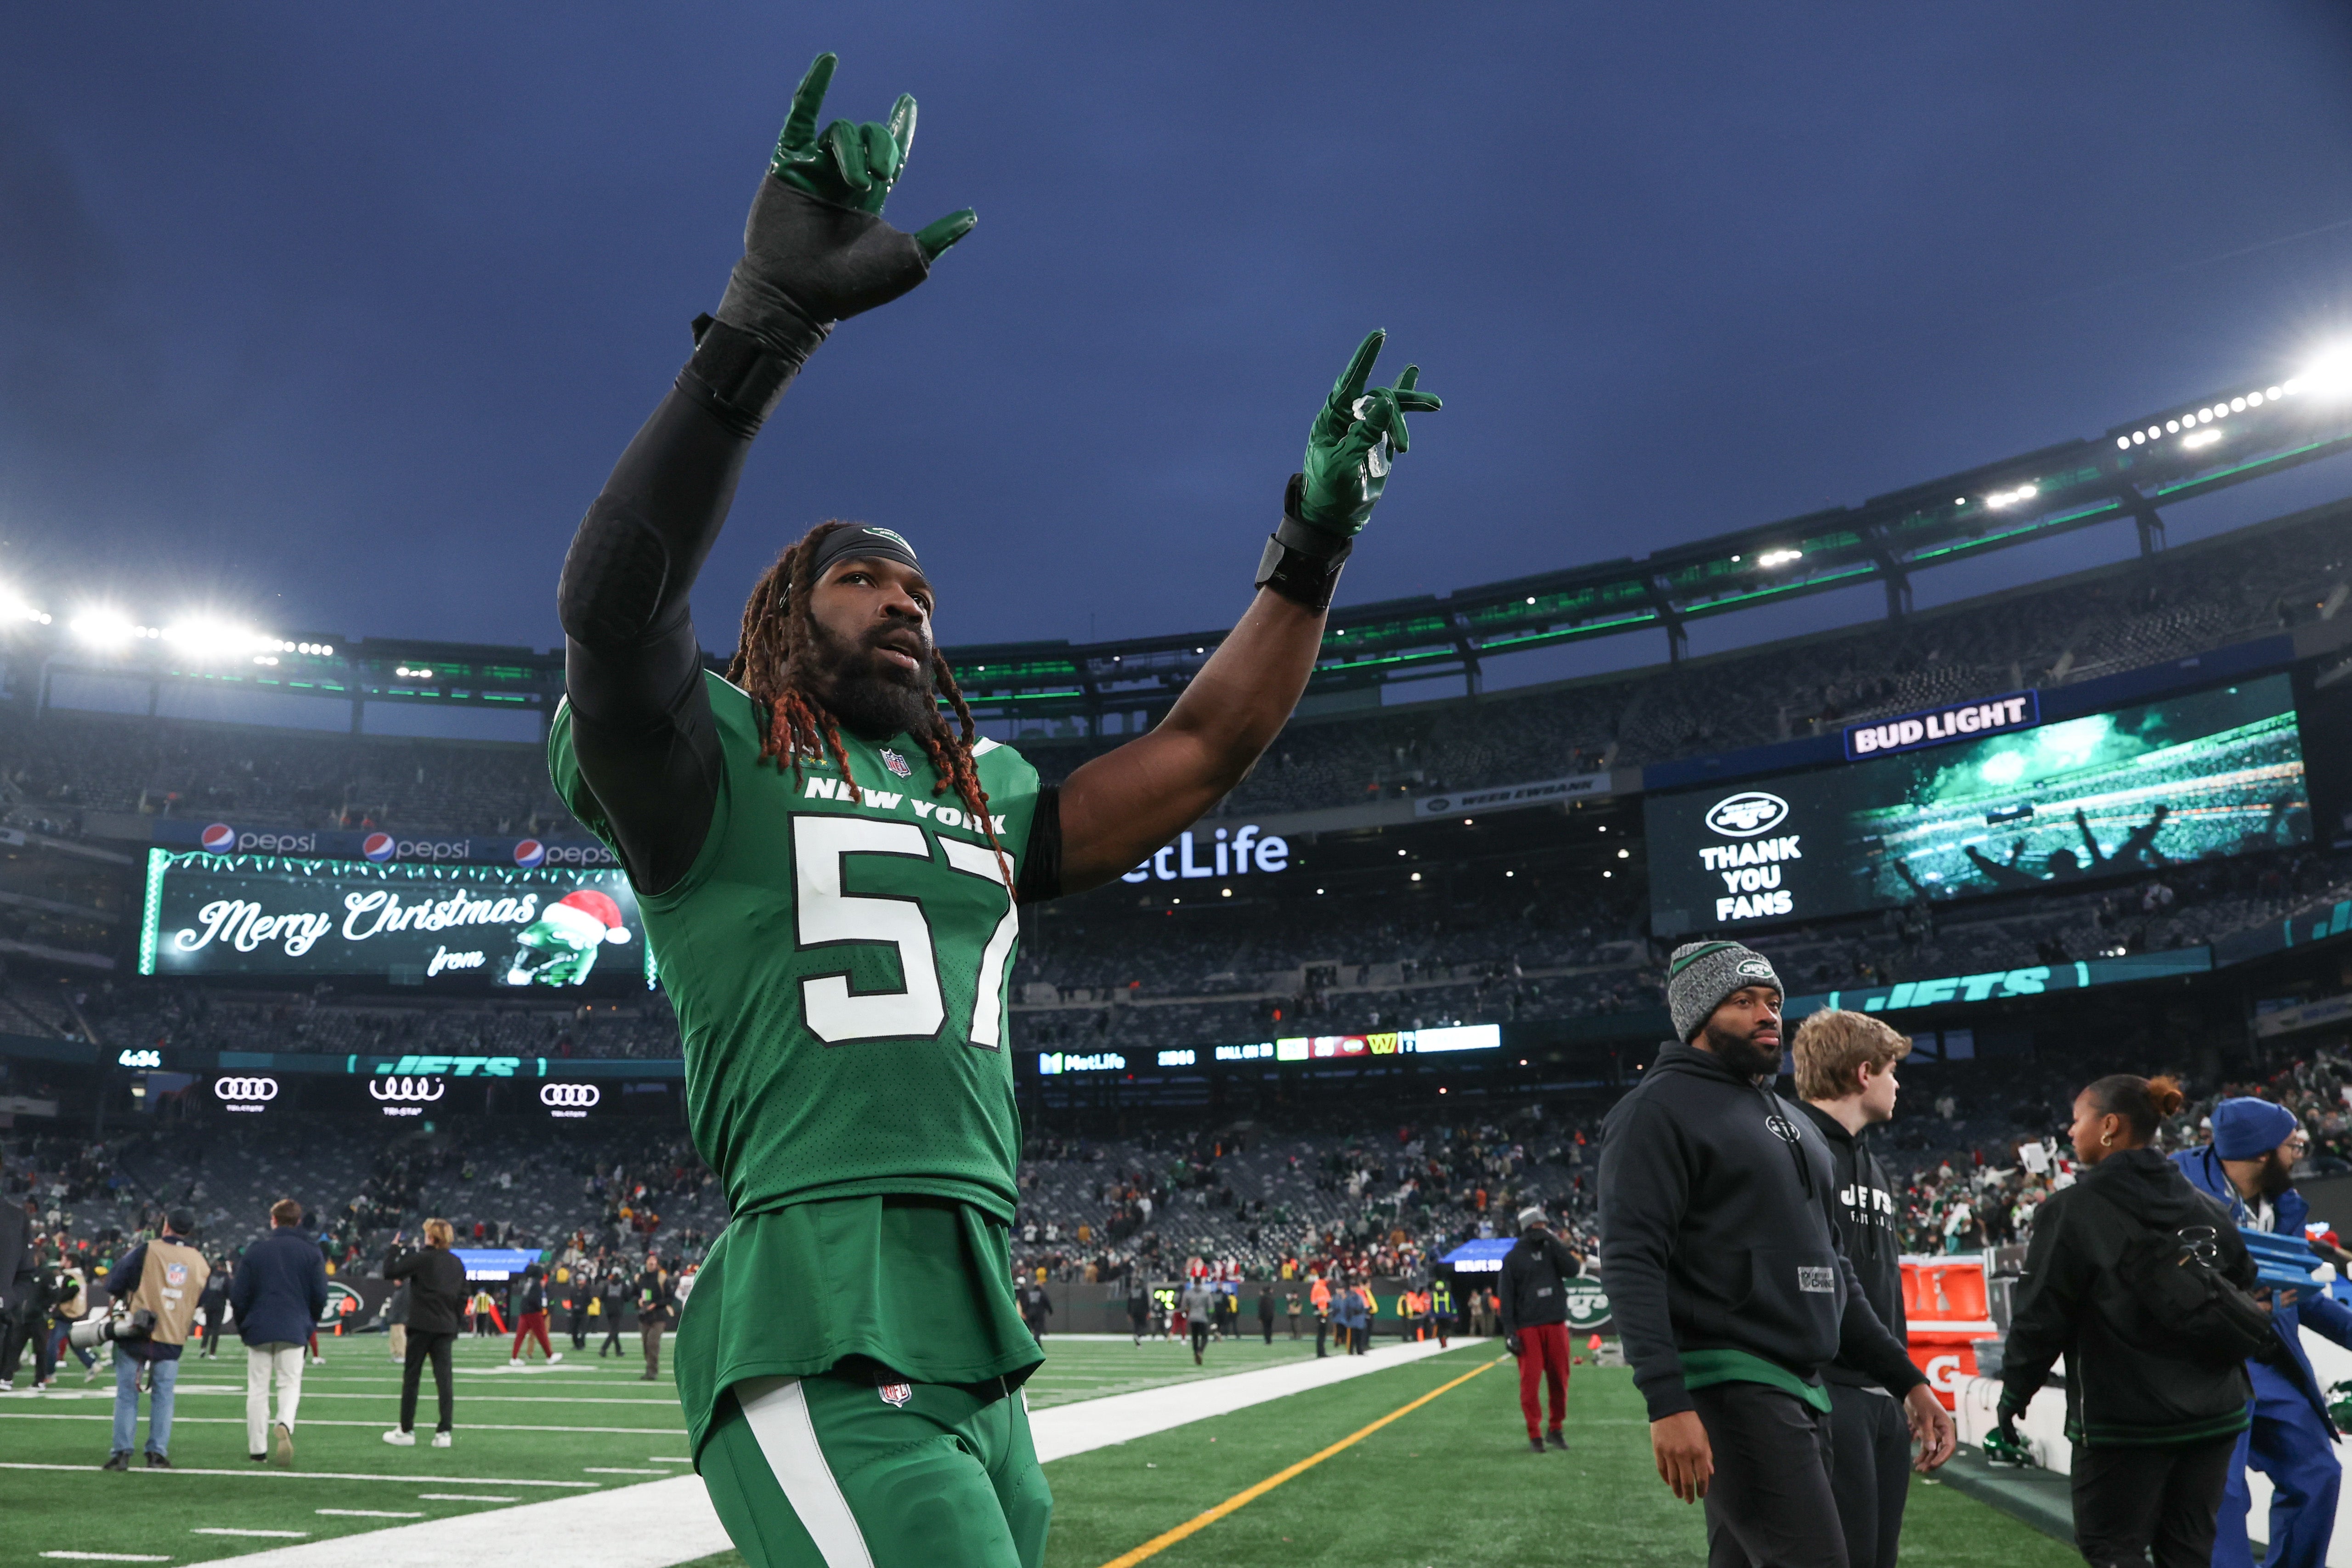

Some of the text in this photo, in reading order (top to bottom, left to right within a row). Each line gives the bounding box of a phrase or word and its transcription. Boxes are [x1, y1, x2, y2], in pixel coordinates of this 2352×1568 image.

[1854, 697, 2026, 754] BUD LIGHT
[804, 777, 1006, 835] NEW YORK
[238, 832, 317, 855] pepsi
[395, 838, 470, 862] pepsi
[545, 846, 616, 866] peps
[1121, 825, 1289, 883] tLife
[1699, 835, 1802, 871] THANK
[1721, 865, 1781, 894] YOU
[1716, 890, 1793, 921] FANS
[174, 888, 539, 957] Merry Christmas
[787, 811, 1019, 1053] 57
[426, 945, 486, 977] from
[1864, 966, 2051, 1012] JETS
[375, 1055, 520, 1077] JETS
[1064, 1053, 1126, 1071] MetLife
[1840, 1183, 1892, 1215] JETS
[1925, 1354, 1961, 1393] G
